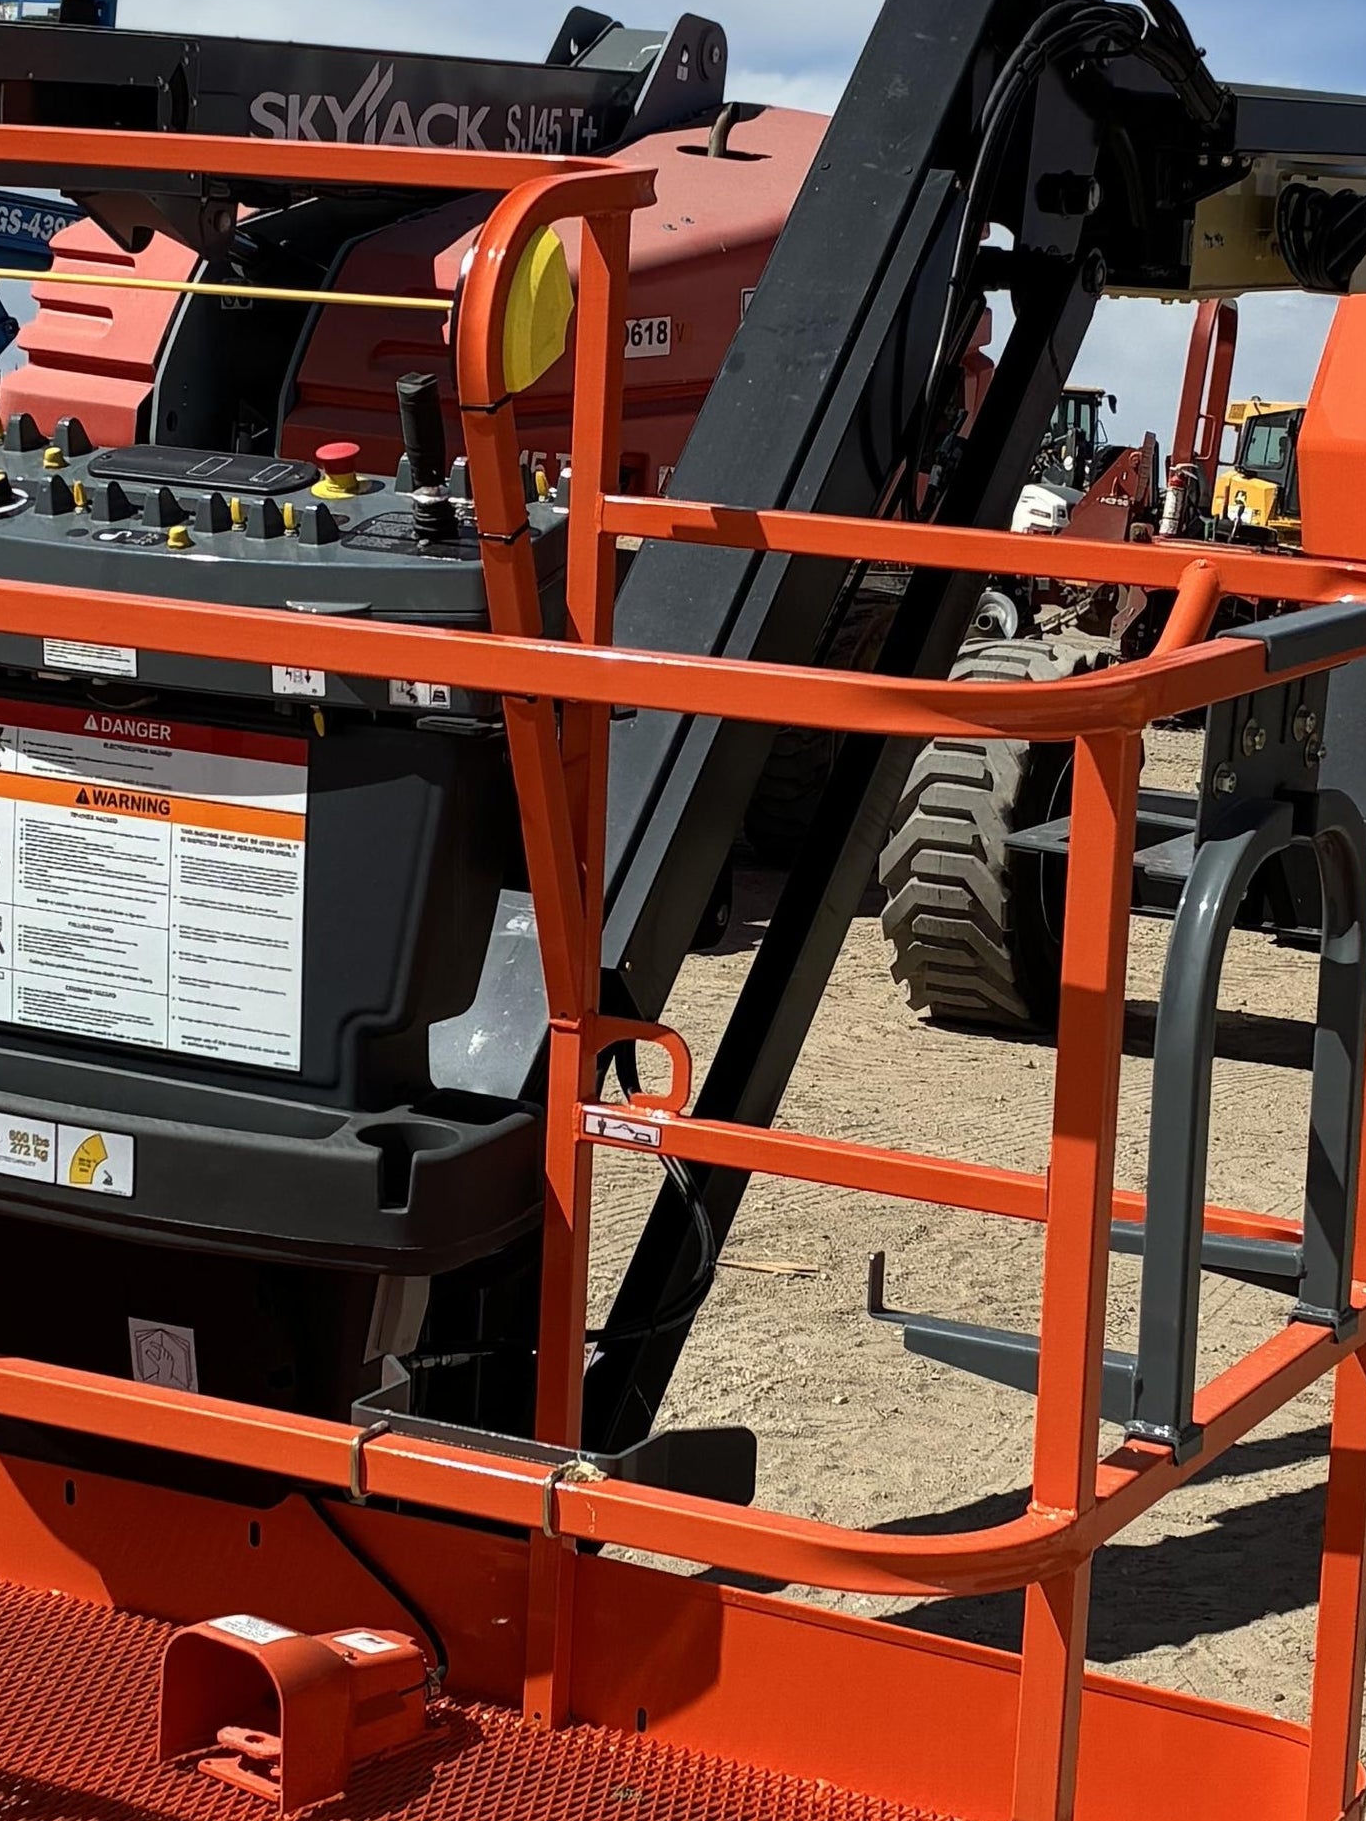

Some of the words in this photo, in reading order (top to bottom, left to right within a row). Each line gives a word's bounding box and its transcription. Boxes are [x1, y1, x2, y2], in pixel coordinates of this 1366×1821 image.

[249, 60, 491, 151] SKYJACK
[101, 716, 172, 741] DANGER
[92, 789, 171, 816] WARNING
[9, 1141, 31, 1156] 272
[33, 1146, 48, 1162] kg
[32, 1133, 50, 1148] lbs
